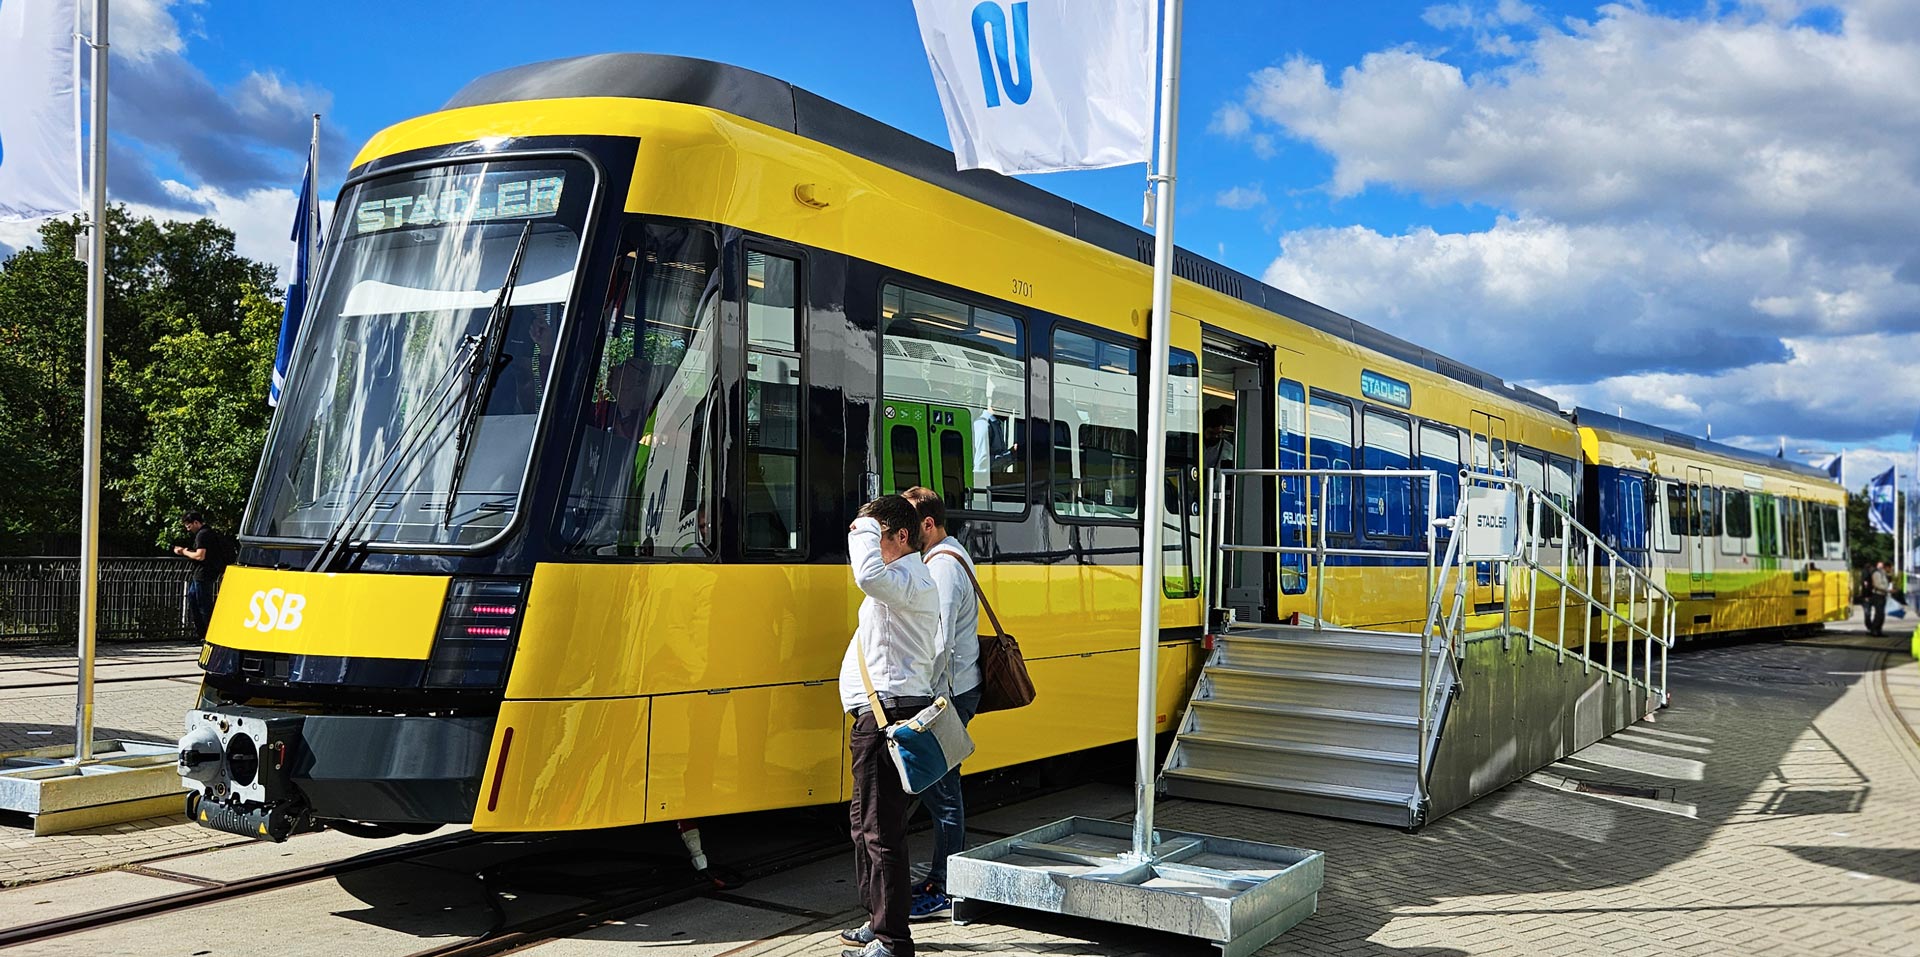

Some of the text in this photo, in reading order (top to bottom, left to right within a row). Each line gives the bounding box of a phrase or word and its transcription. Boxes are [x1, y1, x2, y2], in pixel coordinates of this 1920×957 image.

[357, 177, 564, 233] STADLER
[1012, 278, 1033, 299] 3701
[1361, 374, 1407, 404] STADLER
[1477, 514, 1508, 529] STADLER
[243, 587, 307, 633] SSB
